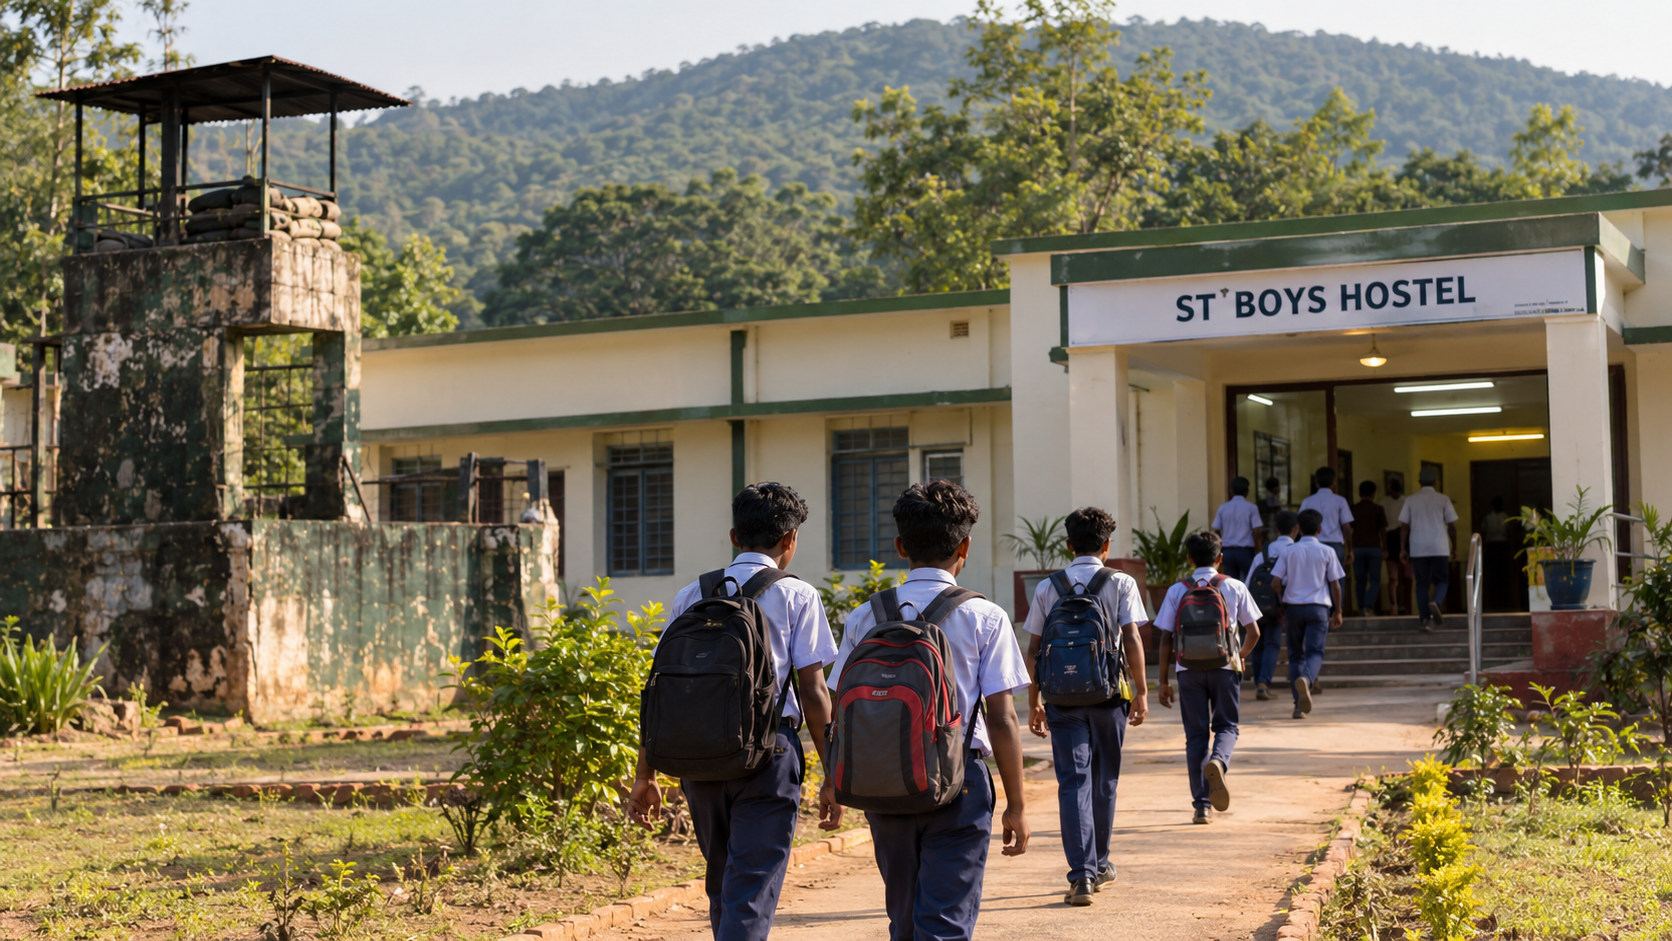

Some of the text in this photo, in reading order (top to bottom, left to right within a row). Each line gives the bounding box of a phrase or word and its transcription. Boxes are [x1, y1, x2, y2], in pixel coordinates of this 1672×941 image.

[1176, 276, 1475, 322] ST BOYS HOSTEL
